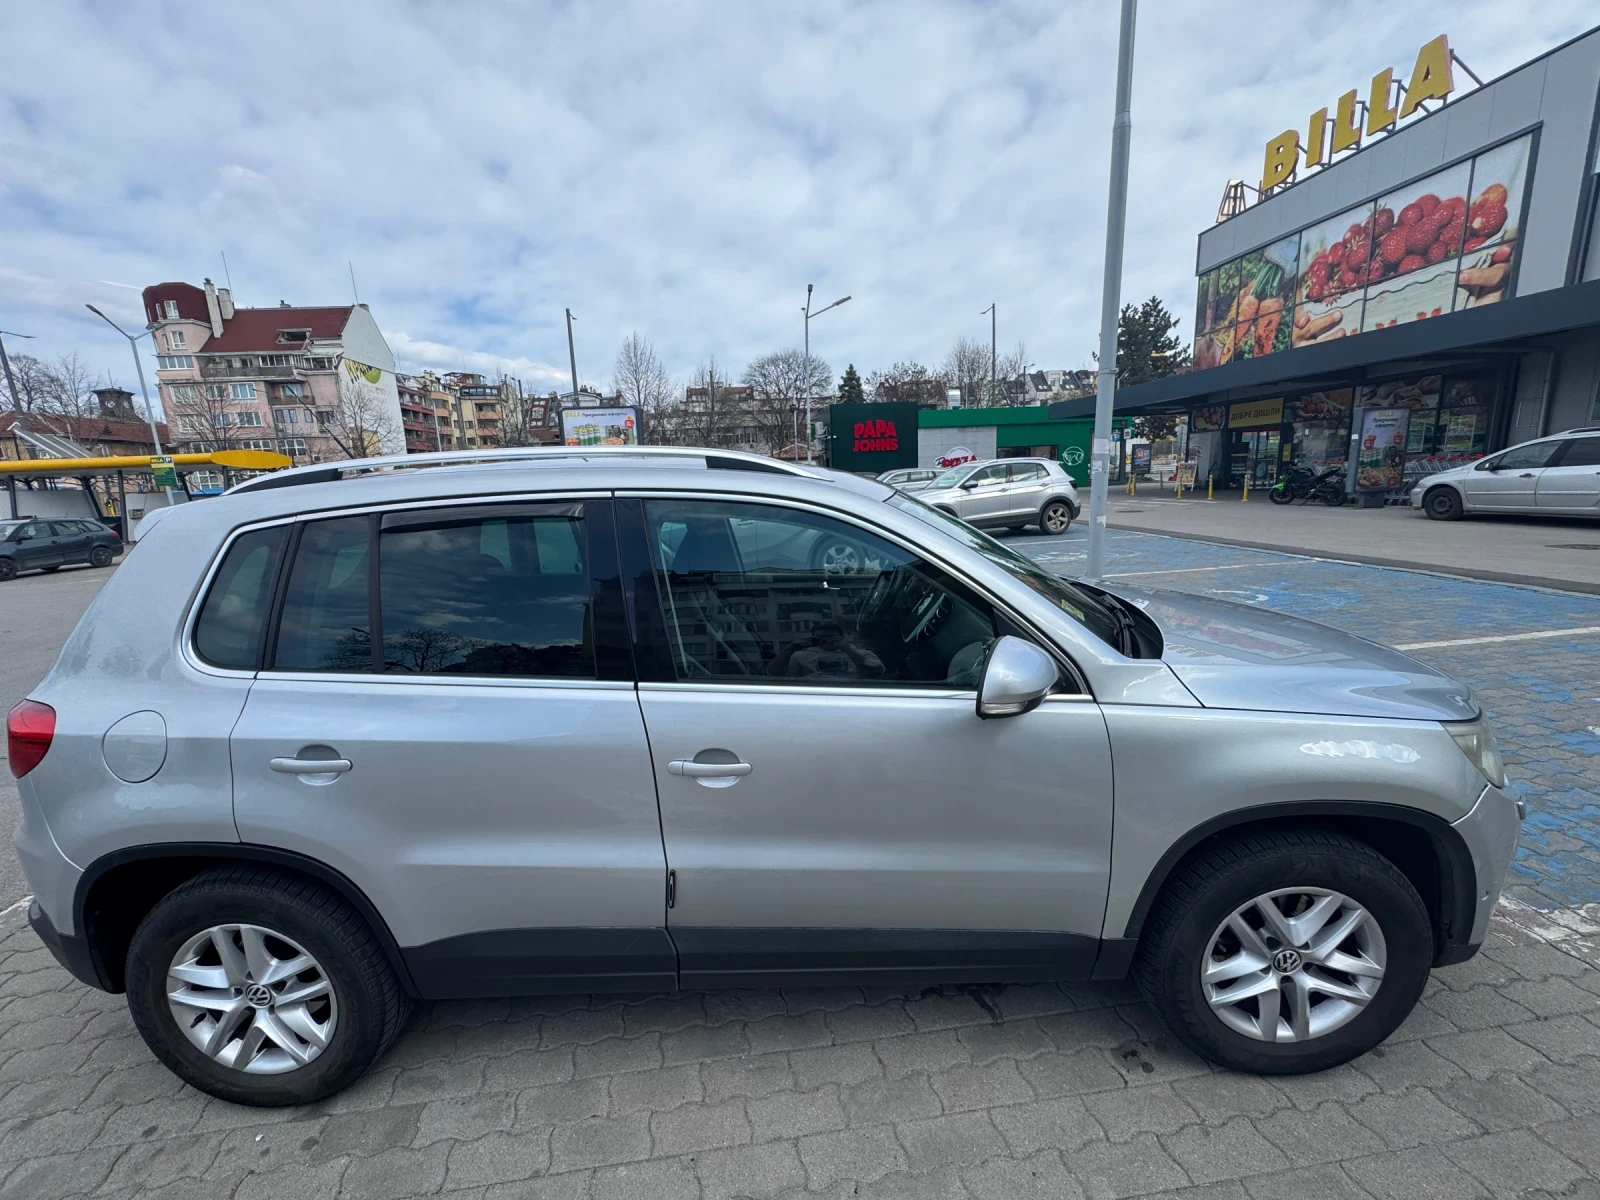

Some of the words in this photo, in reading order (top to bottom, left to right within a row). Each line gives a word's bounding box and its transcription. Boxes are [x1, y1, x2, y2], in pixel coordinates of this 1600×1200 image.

[1262, 34, 1455, 191] BILLA
[1230, 410, 1252, 421] ДОБРЕ
[1253, 407, 1281, 419] ДОШЛИ
[853, 419, 897, 439] PAPA
[852, 438, 899, 453] JOHNS
